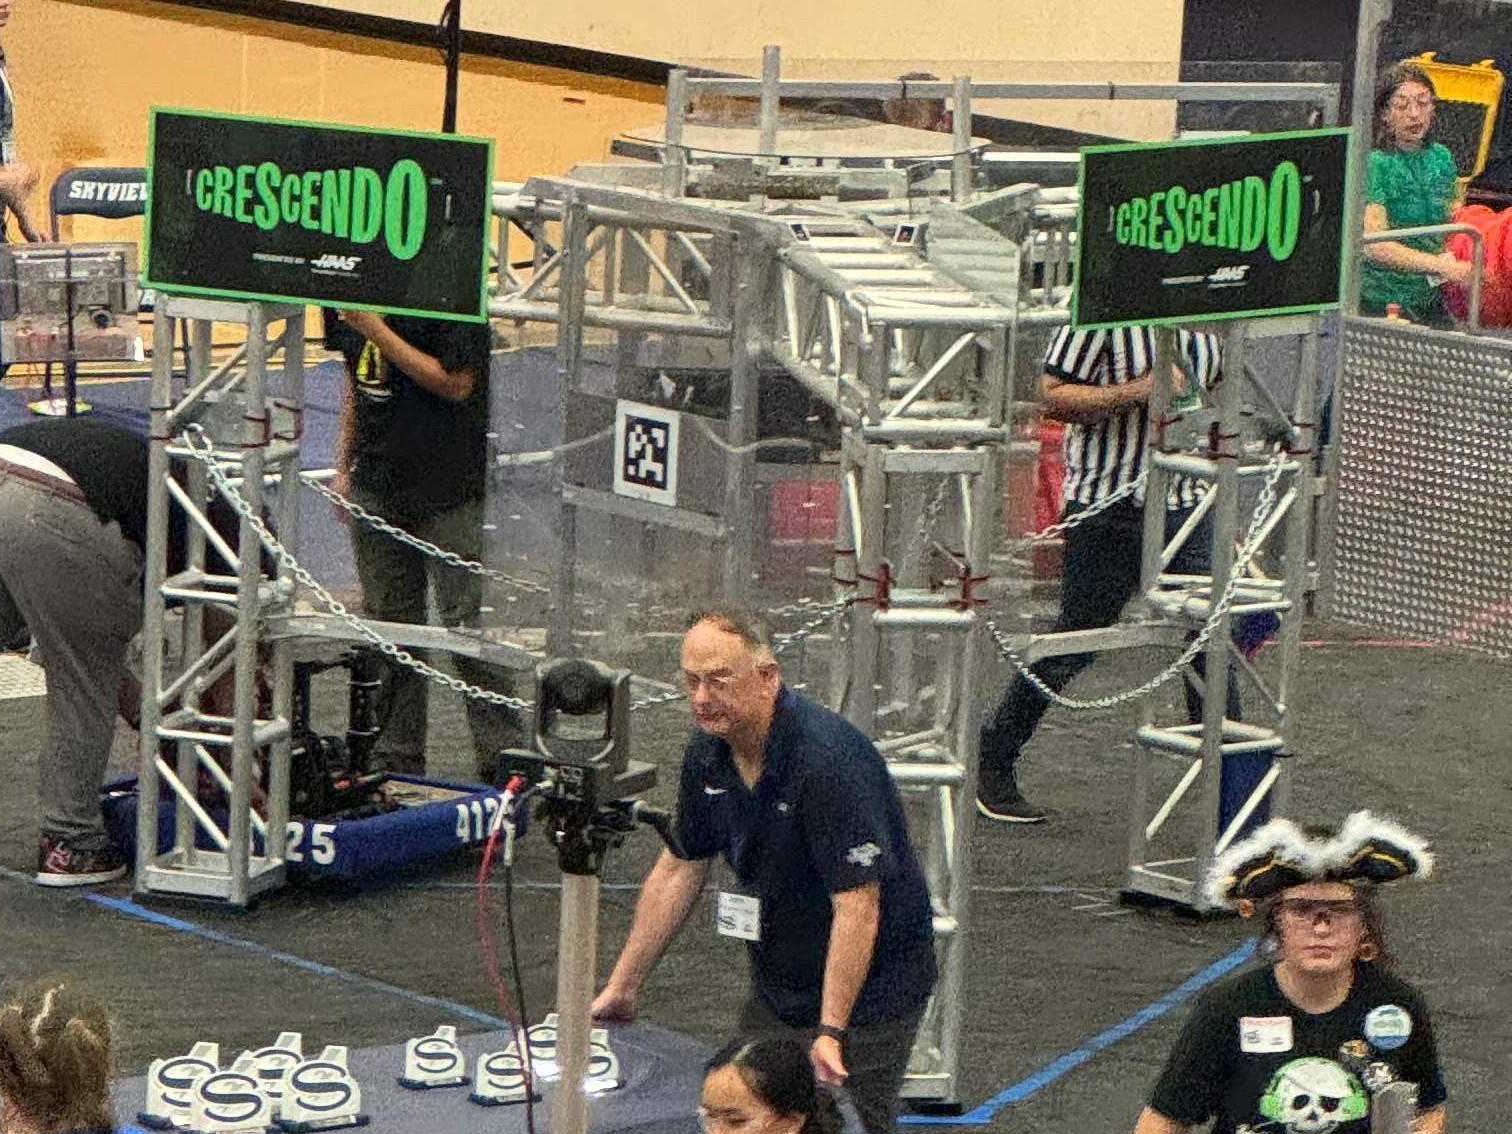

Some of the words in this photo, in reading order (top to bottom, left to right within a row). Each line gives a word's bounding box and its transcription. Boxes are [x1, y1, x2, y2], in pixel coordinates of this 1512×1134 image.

[196, 158, 428, 260] CRESCENDO
[1116, 160, 1302, 261] CRESCENDO
[417, 1037, 458, 1073] S
[200, 1073, 262, 1123] S
[293, 1062, 352, 1111] S
